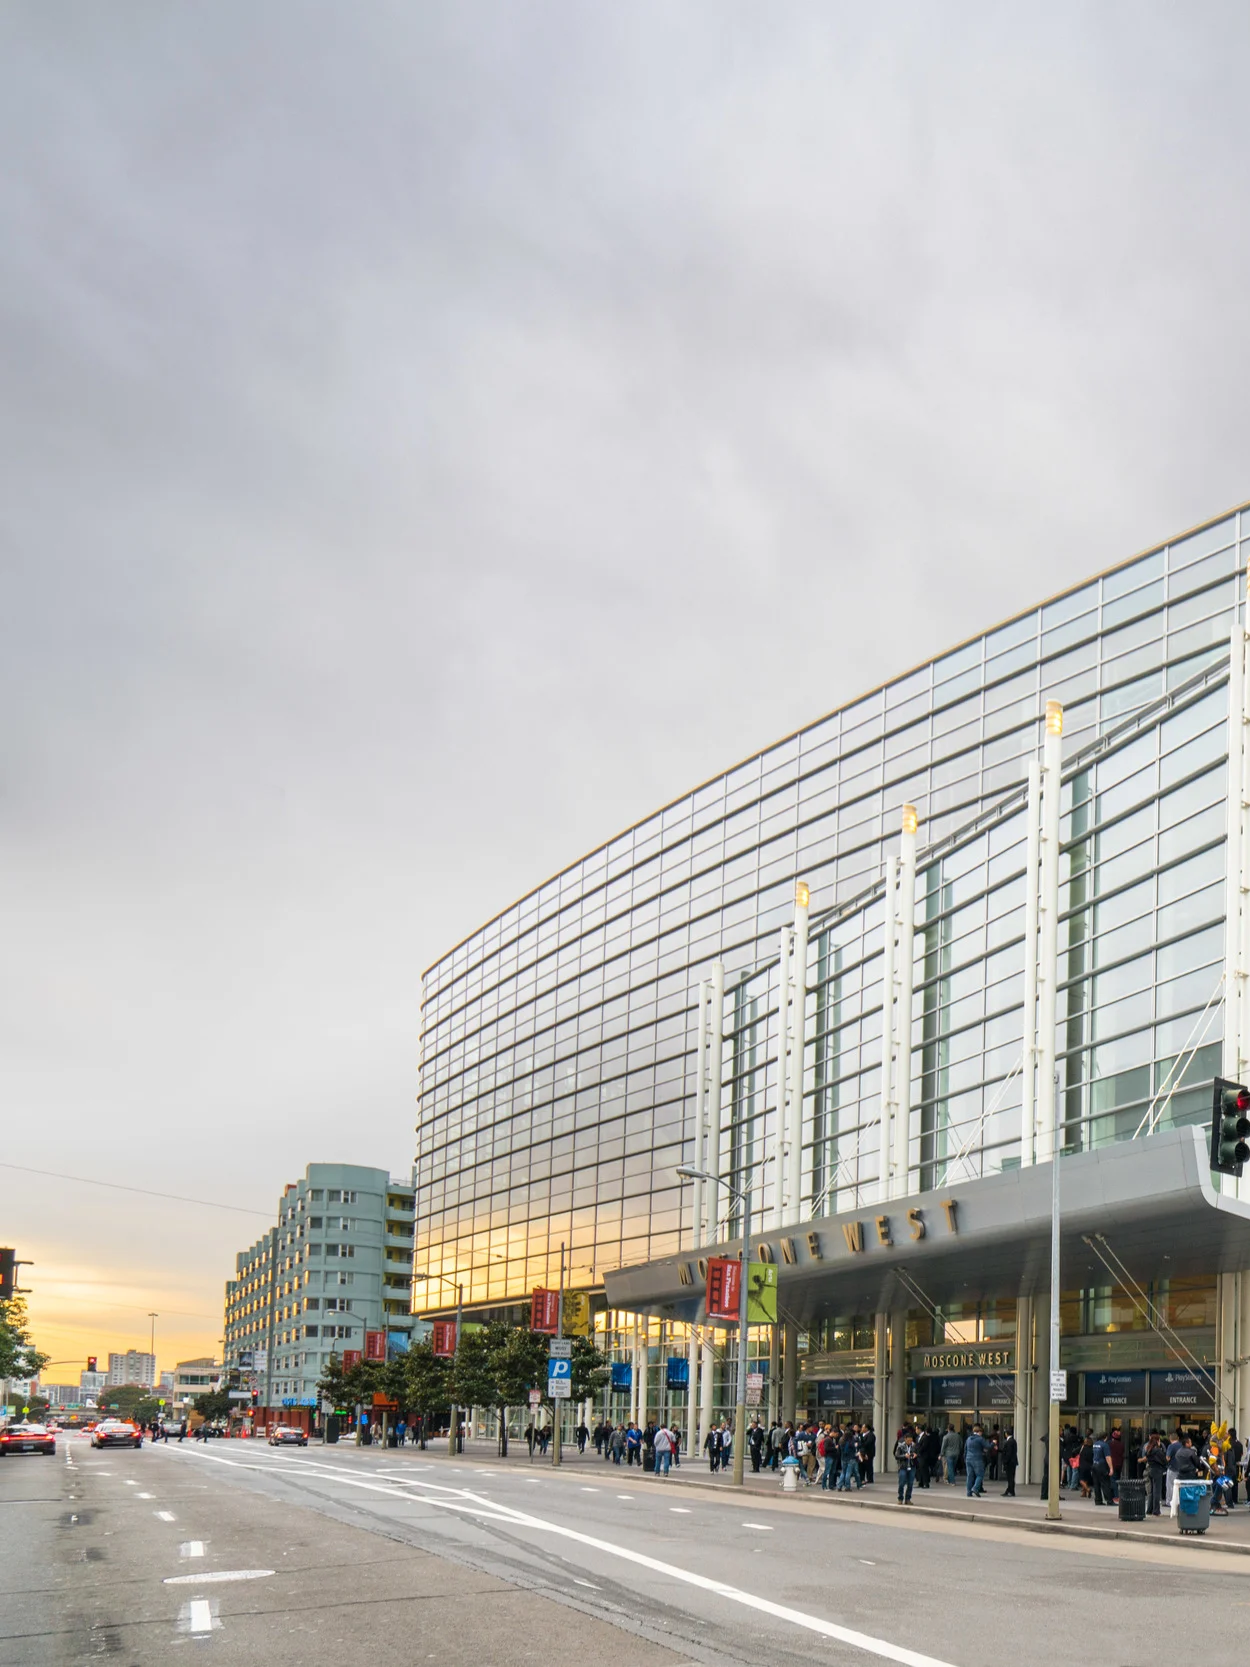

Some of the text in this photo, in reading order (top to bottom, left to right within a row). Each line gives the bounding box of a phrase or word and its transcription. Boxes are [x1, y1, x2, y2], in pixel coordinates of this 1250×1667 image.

[678, 1199, 958, 1285] MOONE WEST
[923, 1351, 1009, 1368] MOSCONE WEST
[552, 1361, 569, 1377] P
[1108, 1375, 1132, 1385] PlayStation
[1175, 1373, 1202, 1383] PlayStation
[1103, 1397, 1127, 1405] ENTRANCE
[1169, 1396, 1197, 1404] ENTRANCE
